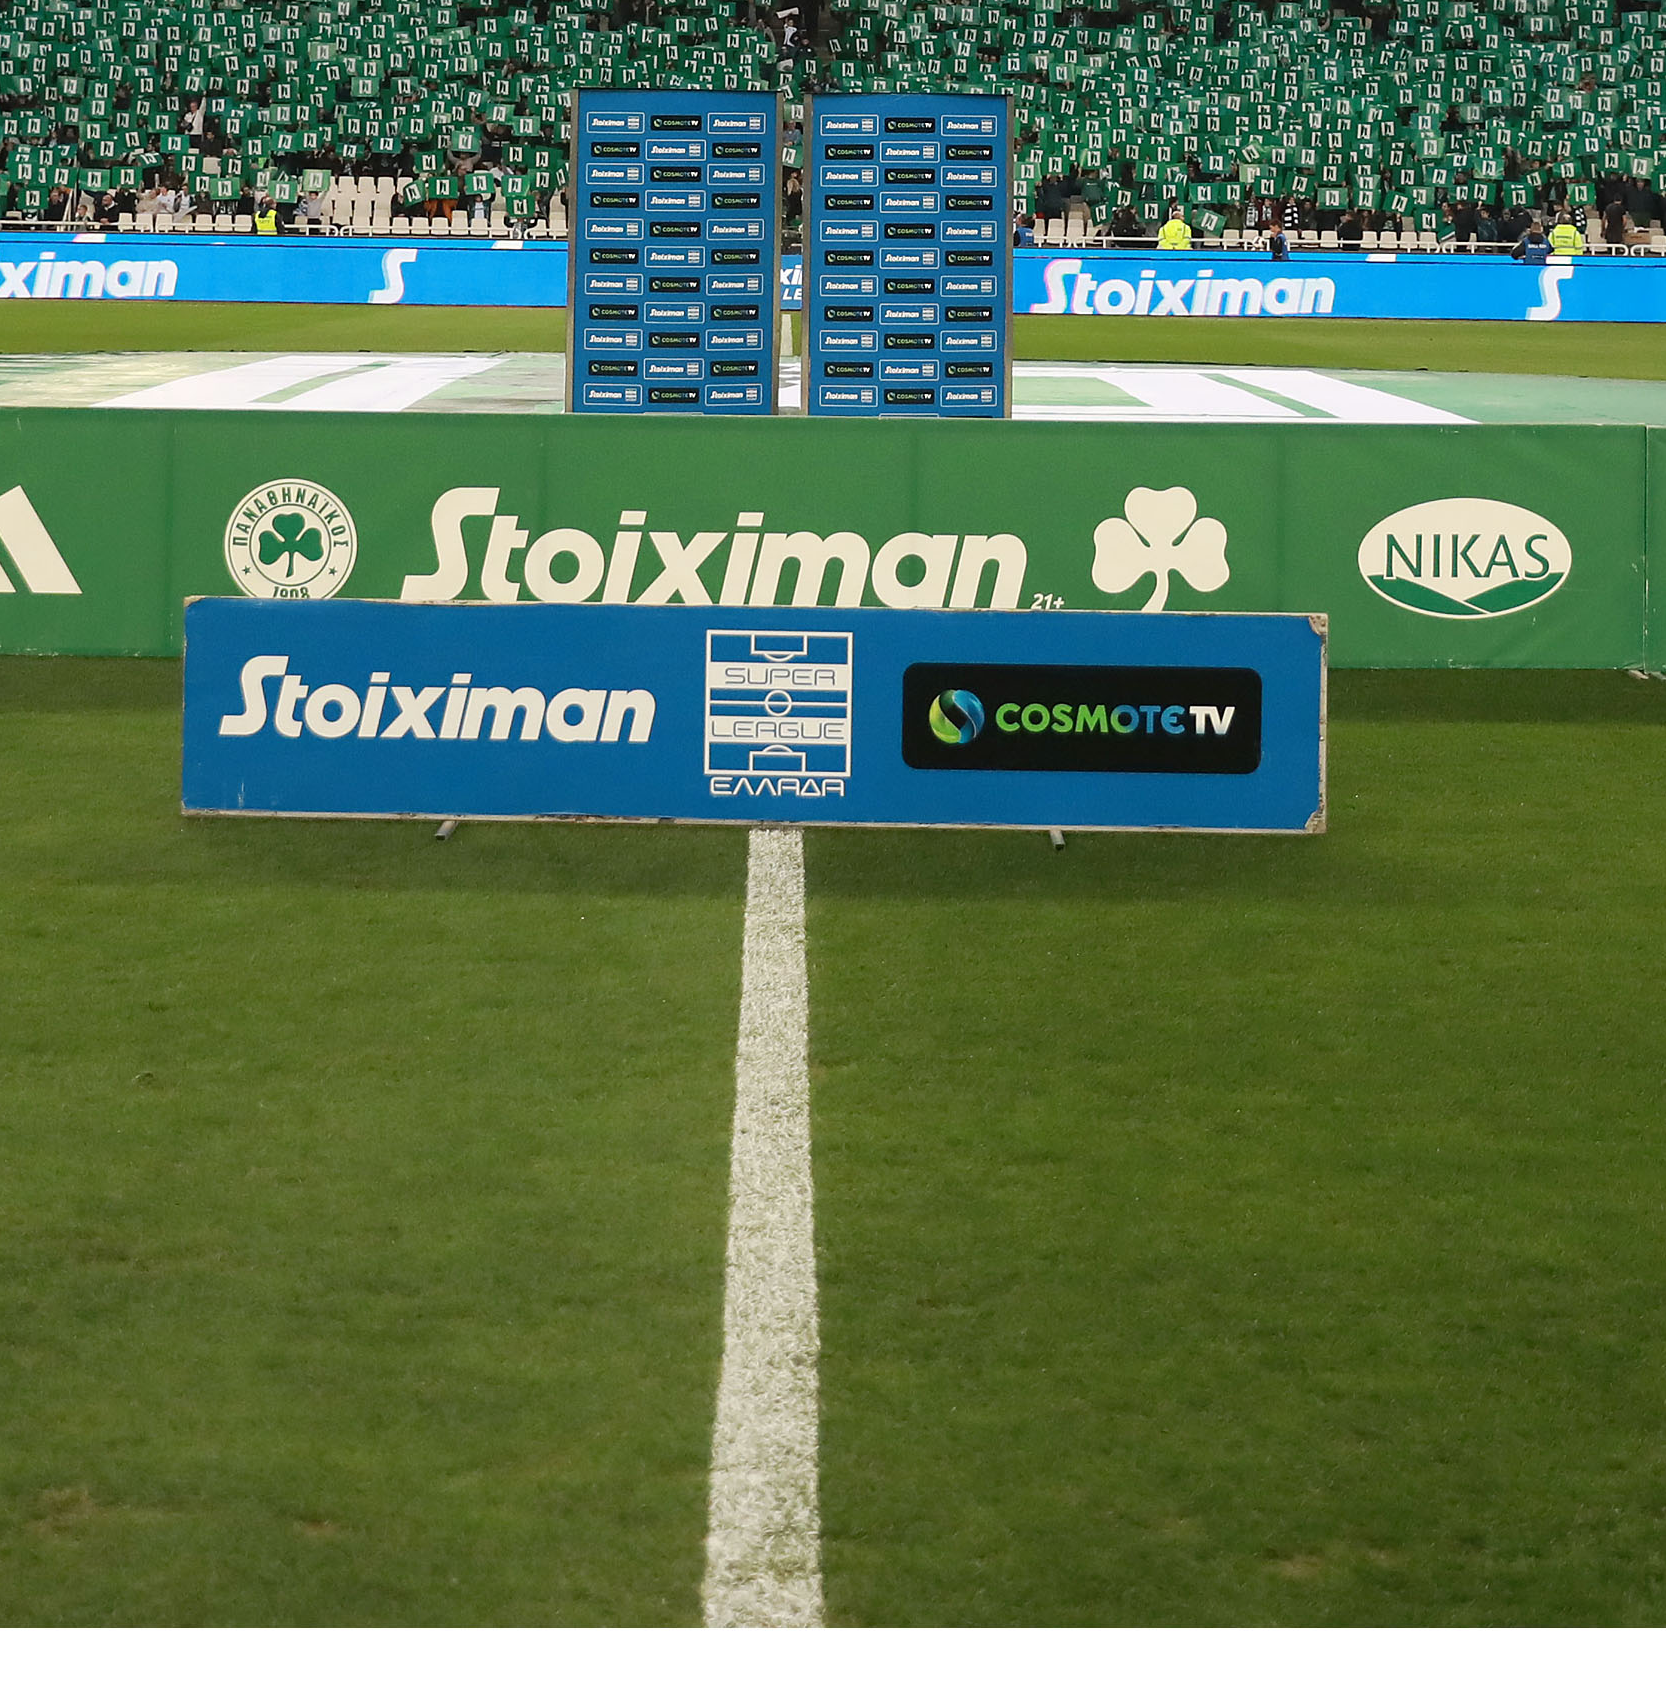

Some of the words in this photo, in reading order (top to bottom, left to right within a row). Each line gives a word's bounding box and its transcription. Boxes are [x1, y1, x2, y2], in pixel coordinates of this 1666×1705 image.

[1031, 259, 1335, 316] Stoiximan
[401, 487, 1027, 606] Stoiximan
[1385, 533, 1550, 579] NIKAS
[218, 655, 656, 743] Stoiximan
[725, 667, 836, 686] SUPER
[711, 720, 846, 740] LEAGUE
